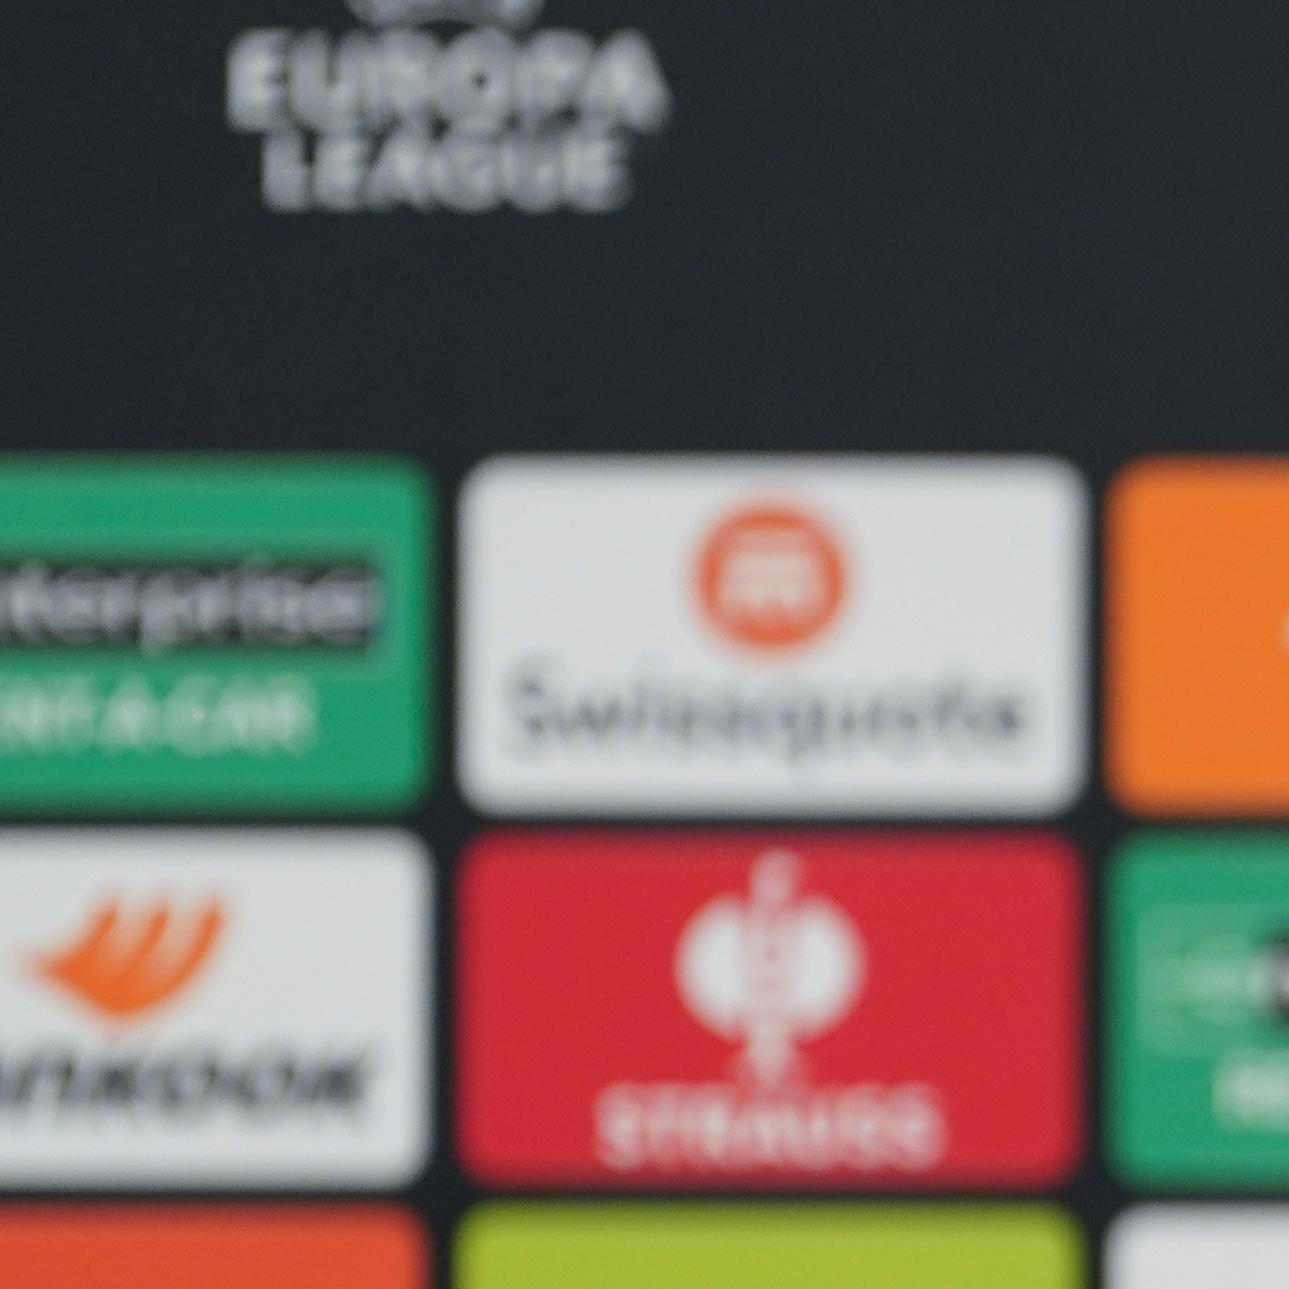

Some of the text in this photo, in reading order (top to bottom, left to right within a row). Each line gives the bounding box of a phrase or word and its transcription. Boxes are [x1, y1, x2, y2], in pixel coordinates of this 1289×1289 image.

[230, 30, 668, 132] EUROPA
[263, 134, 630, 210] LEAGUE
[597, 1081, 942, 1171] STRAUSS
